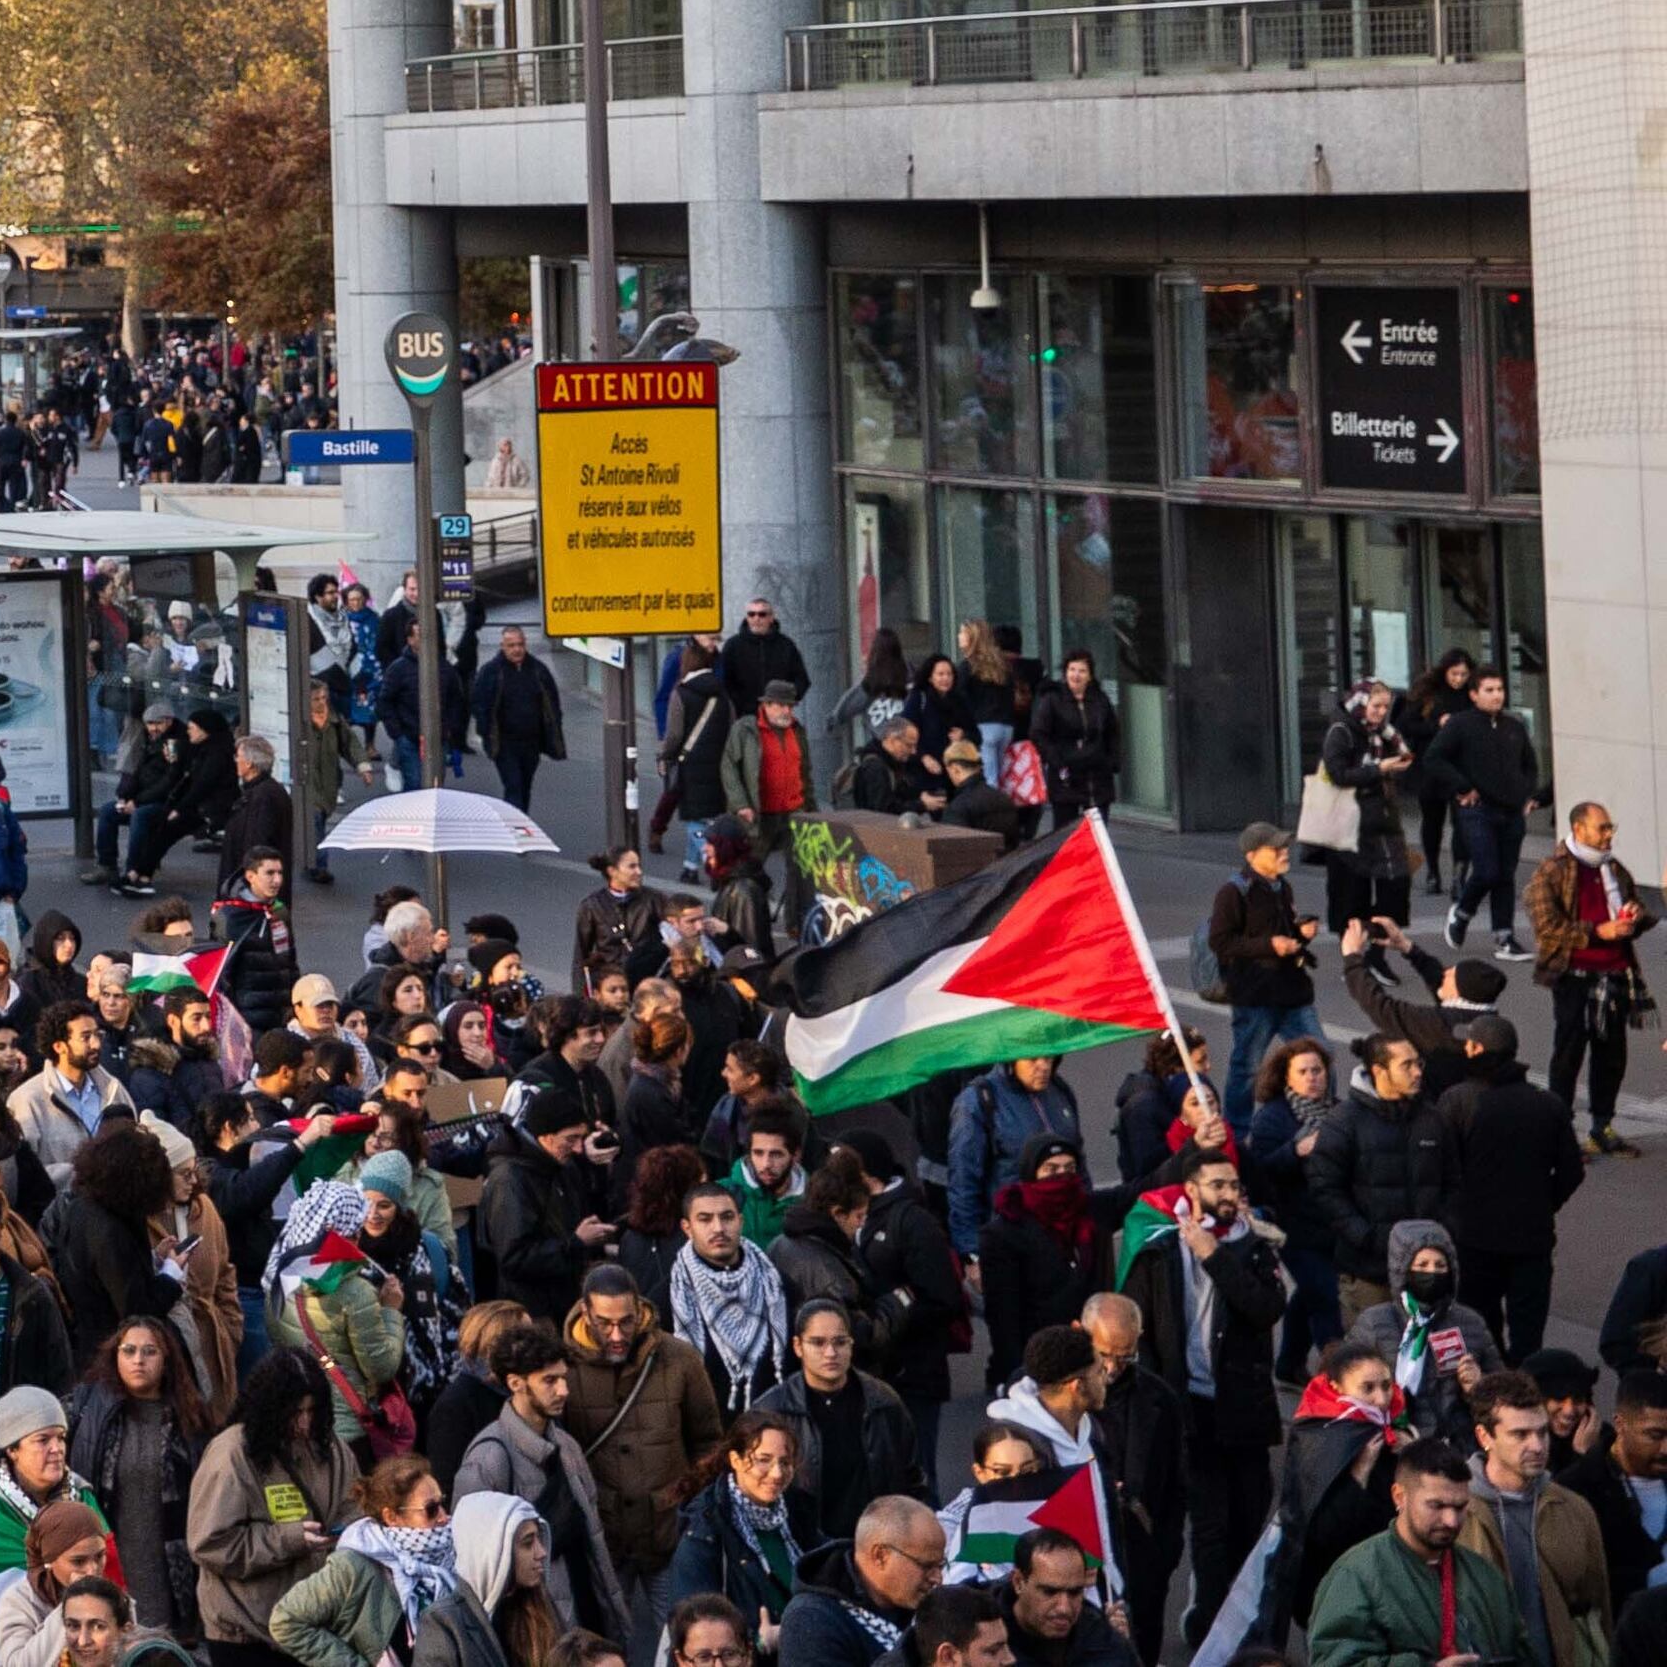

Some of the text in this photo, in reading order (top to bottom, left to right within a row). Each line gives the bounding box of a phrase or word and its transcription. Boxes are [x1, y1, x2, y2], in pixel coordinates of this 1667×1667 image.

[1379, 318, 1438, 343] Entrée
[398, 332, 444, 358] BUS
[1380, 345, 1436, 366] Entrance
[553, 372, 704, 402] ATTENTION
[1331, 411, 1416, 439] Billetterie
[323, 441, 379, 456] Bastille
[610, 432, 648, 454] Accès
[1372, 442, 1416, 464] Tickets
[580, 463, 679, 486] St Antoine Rivoli
[579, 494, 682, 517] réservé aux vélos
[444, 519, 466, 535] 29
[567, 525, 695, 550] et véhicules autorisés
[552, 588, 715, 614] contournement par les quais
